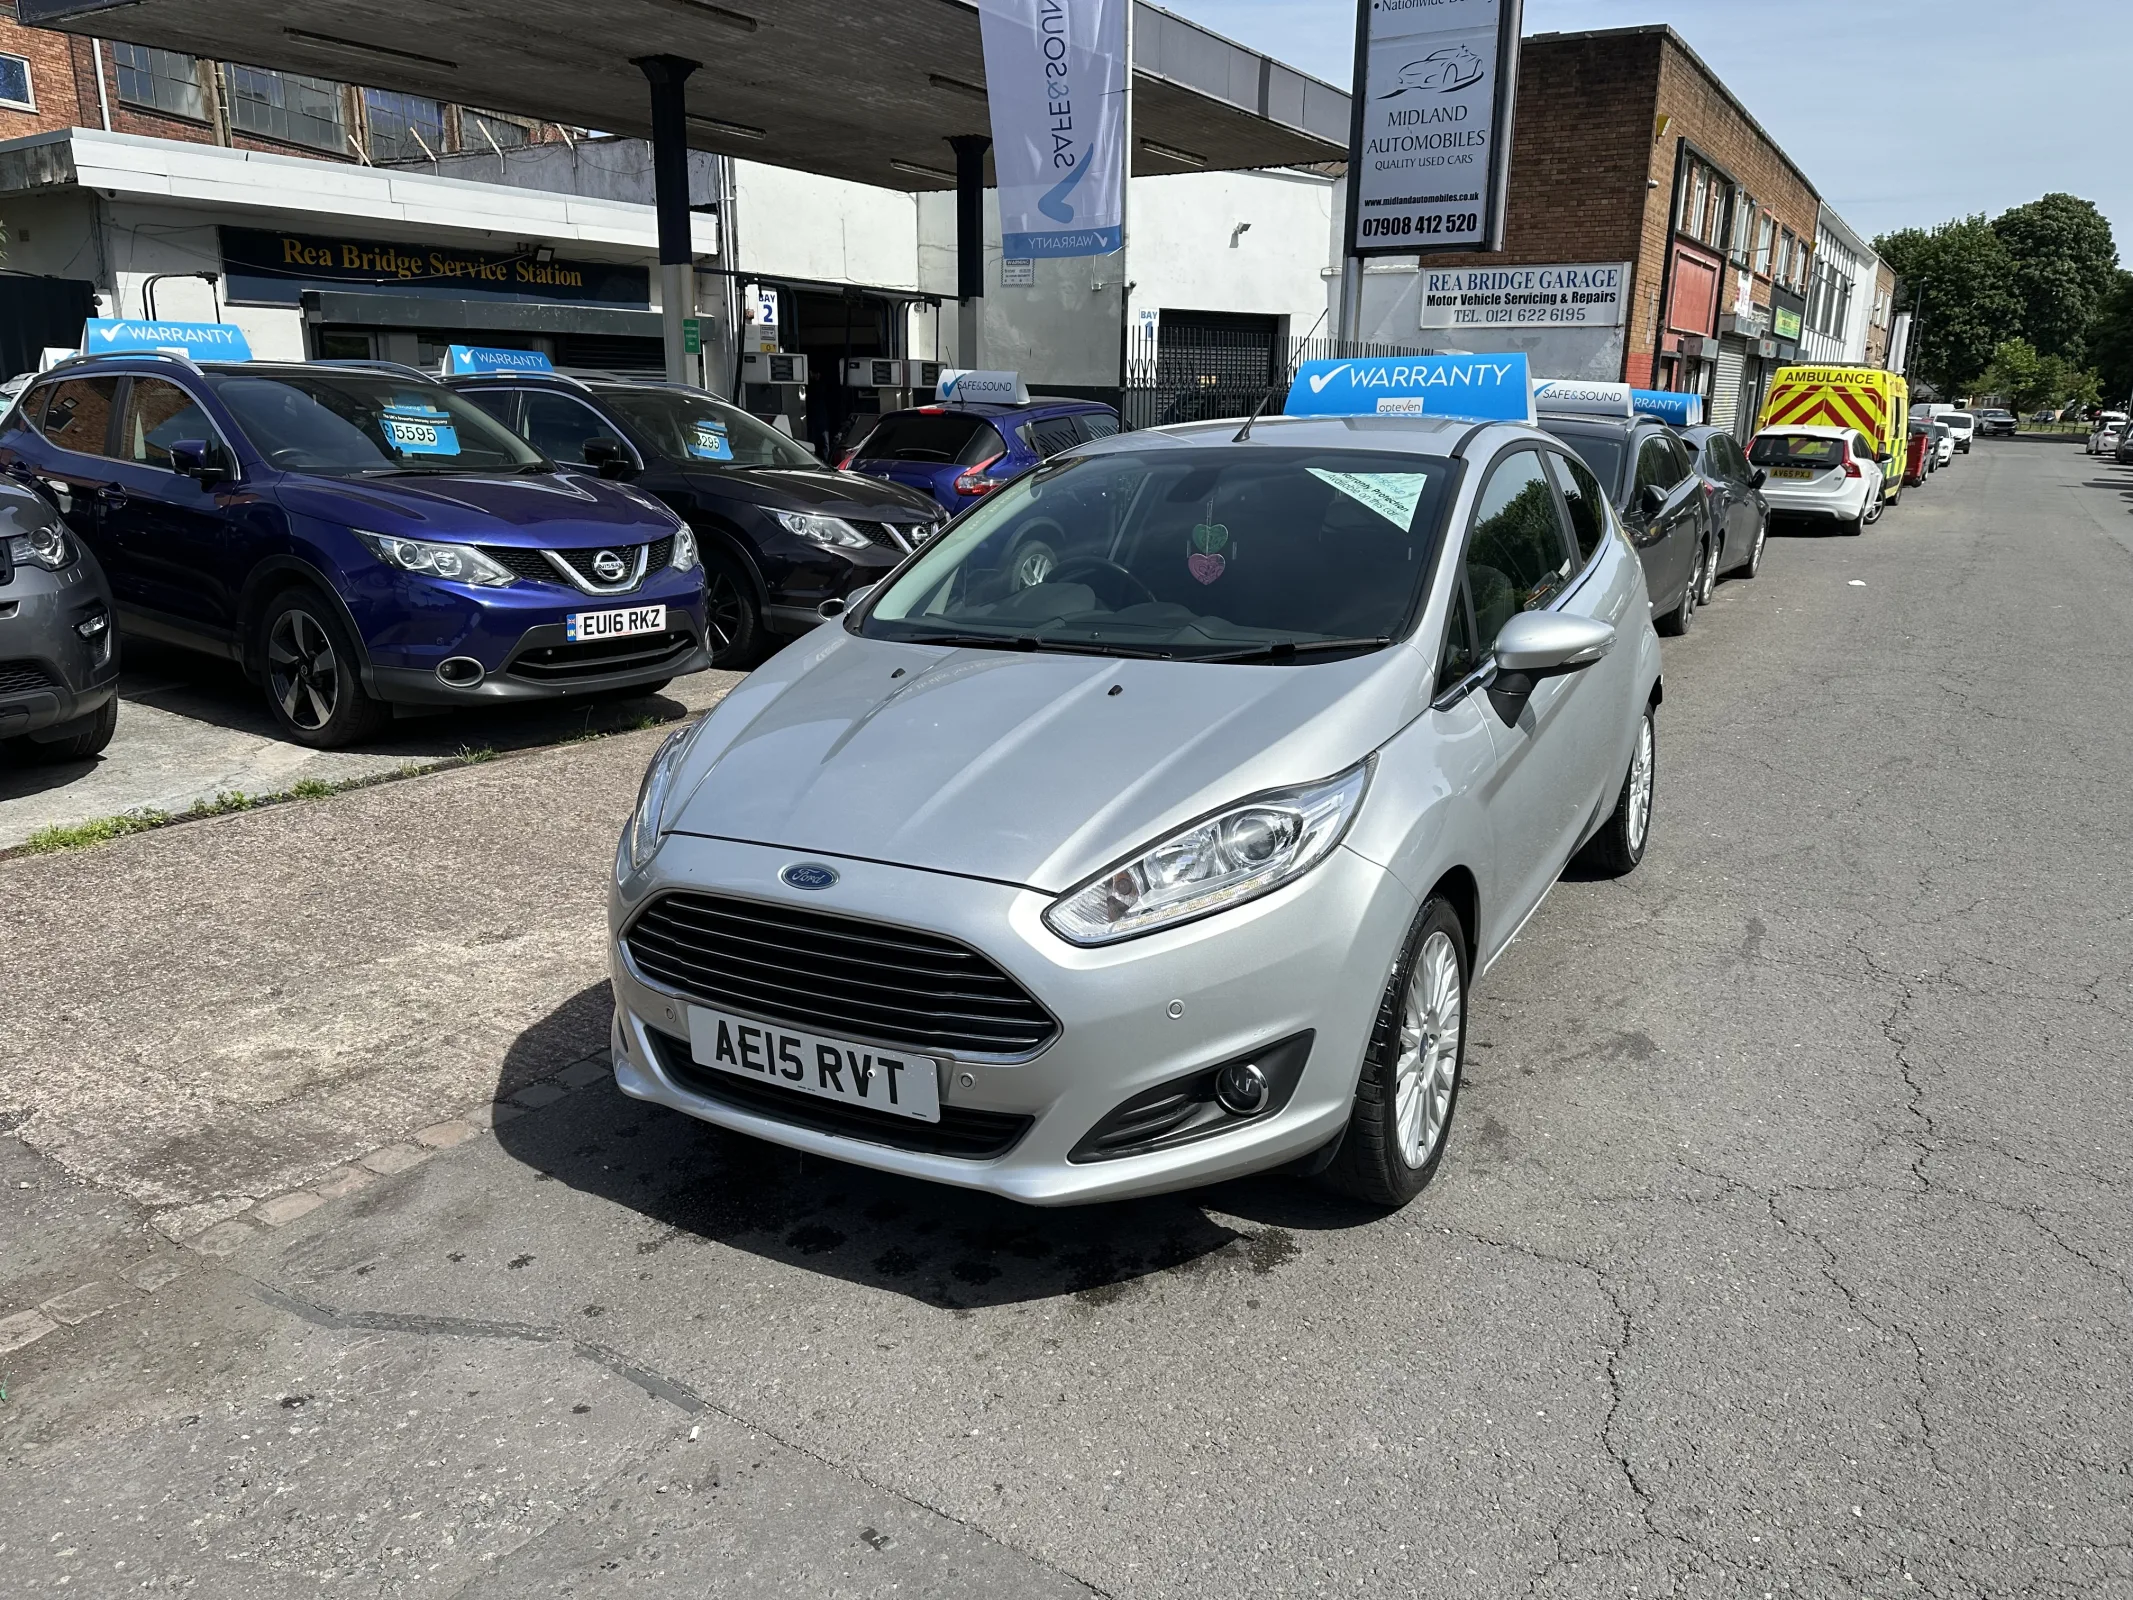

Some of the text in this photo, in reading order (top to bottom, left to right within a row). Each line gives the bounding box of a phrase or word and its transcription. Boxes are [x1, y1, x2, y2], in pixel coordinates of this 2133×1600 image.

[1388, 105, 1468, 127] MIDLAND
[1367, 130, 1486, 154] AUTOMOBILES
[1375, 154, 1473, 171] QUALITY USED CARS
[1364, 192, 1479, 207] www.midlandautomobiles.co.uk
[1362, 213, 1477, 236] 07908 412 520
[281, 238, 582, 287] Rea Bridge Service Station
[1428, 269, 1618, 291] REA BRIDGE GARAGE
[1426, 290, 1616, 306] Motor Vehicle Servicing & Repairs
[763, 304, 773, 323] 2
[1140, 310, 1158, 319] BAY
[1454, 308, 1586, 323] TEL. 0121 622 6195
[126, 325, 234, 344] WARRANTY
[475, 351, 543, 367] WARRANTY
[1350, 363, 1512, 388] WARRANTY
[1785, 371, 1875, 385] AMBULANCE
[1543, 388, 1622, 402] SAFE&SOUND
[1379, 399, 1420, 412] opteven
[1327, 474, 1360, 494] Available
[1358, 492, 1370, 501] on
[1383, 507, 1399, 516] car
[1373, 488, 1409, 512] Protection
[583, 608, 660, 636] EU16 RKZ
[567, 629, 576, 637] UK
[792, 868, 826, 884] Ford
[715, 1019, 904, 1105] AE15 RVT
